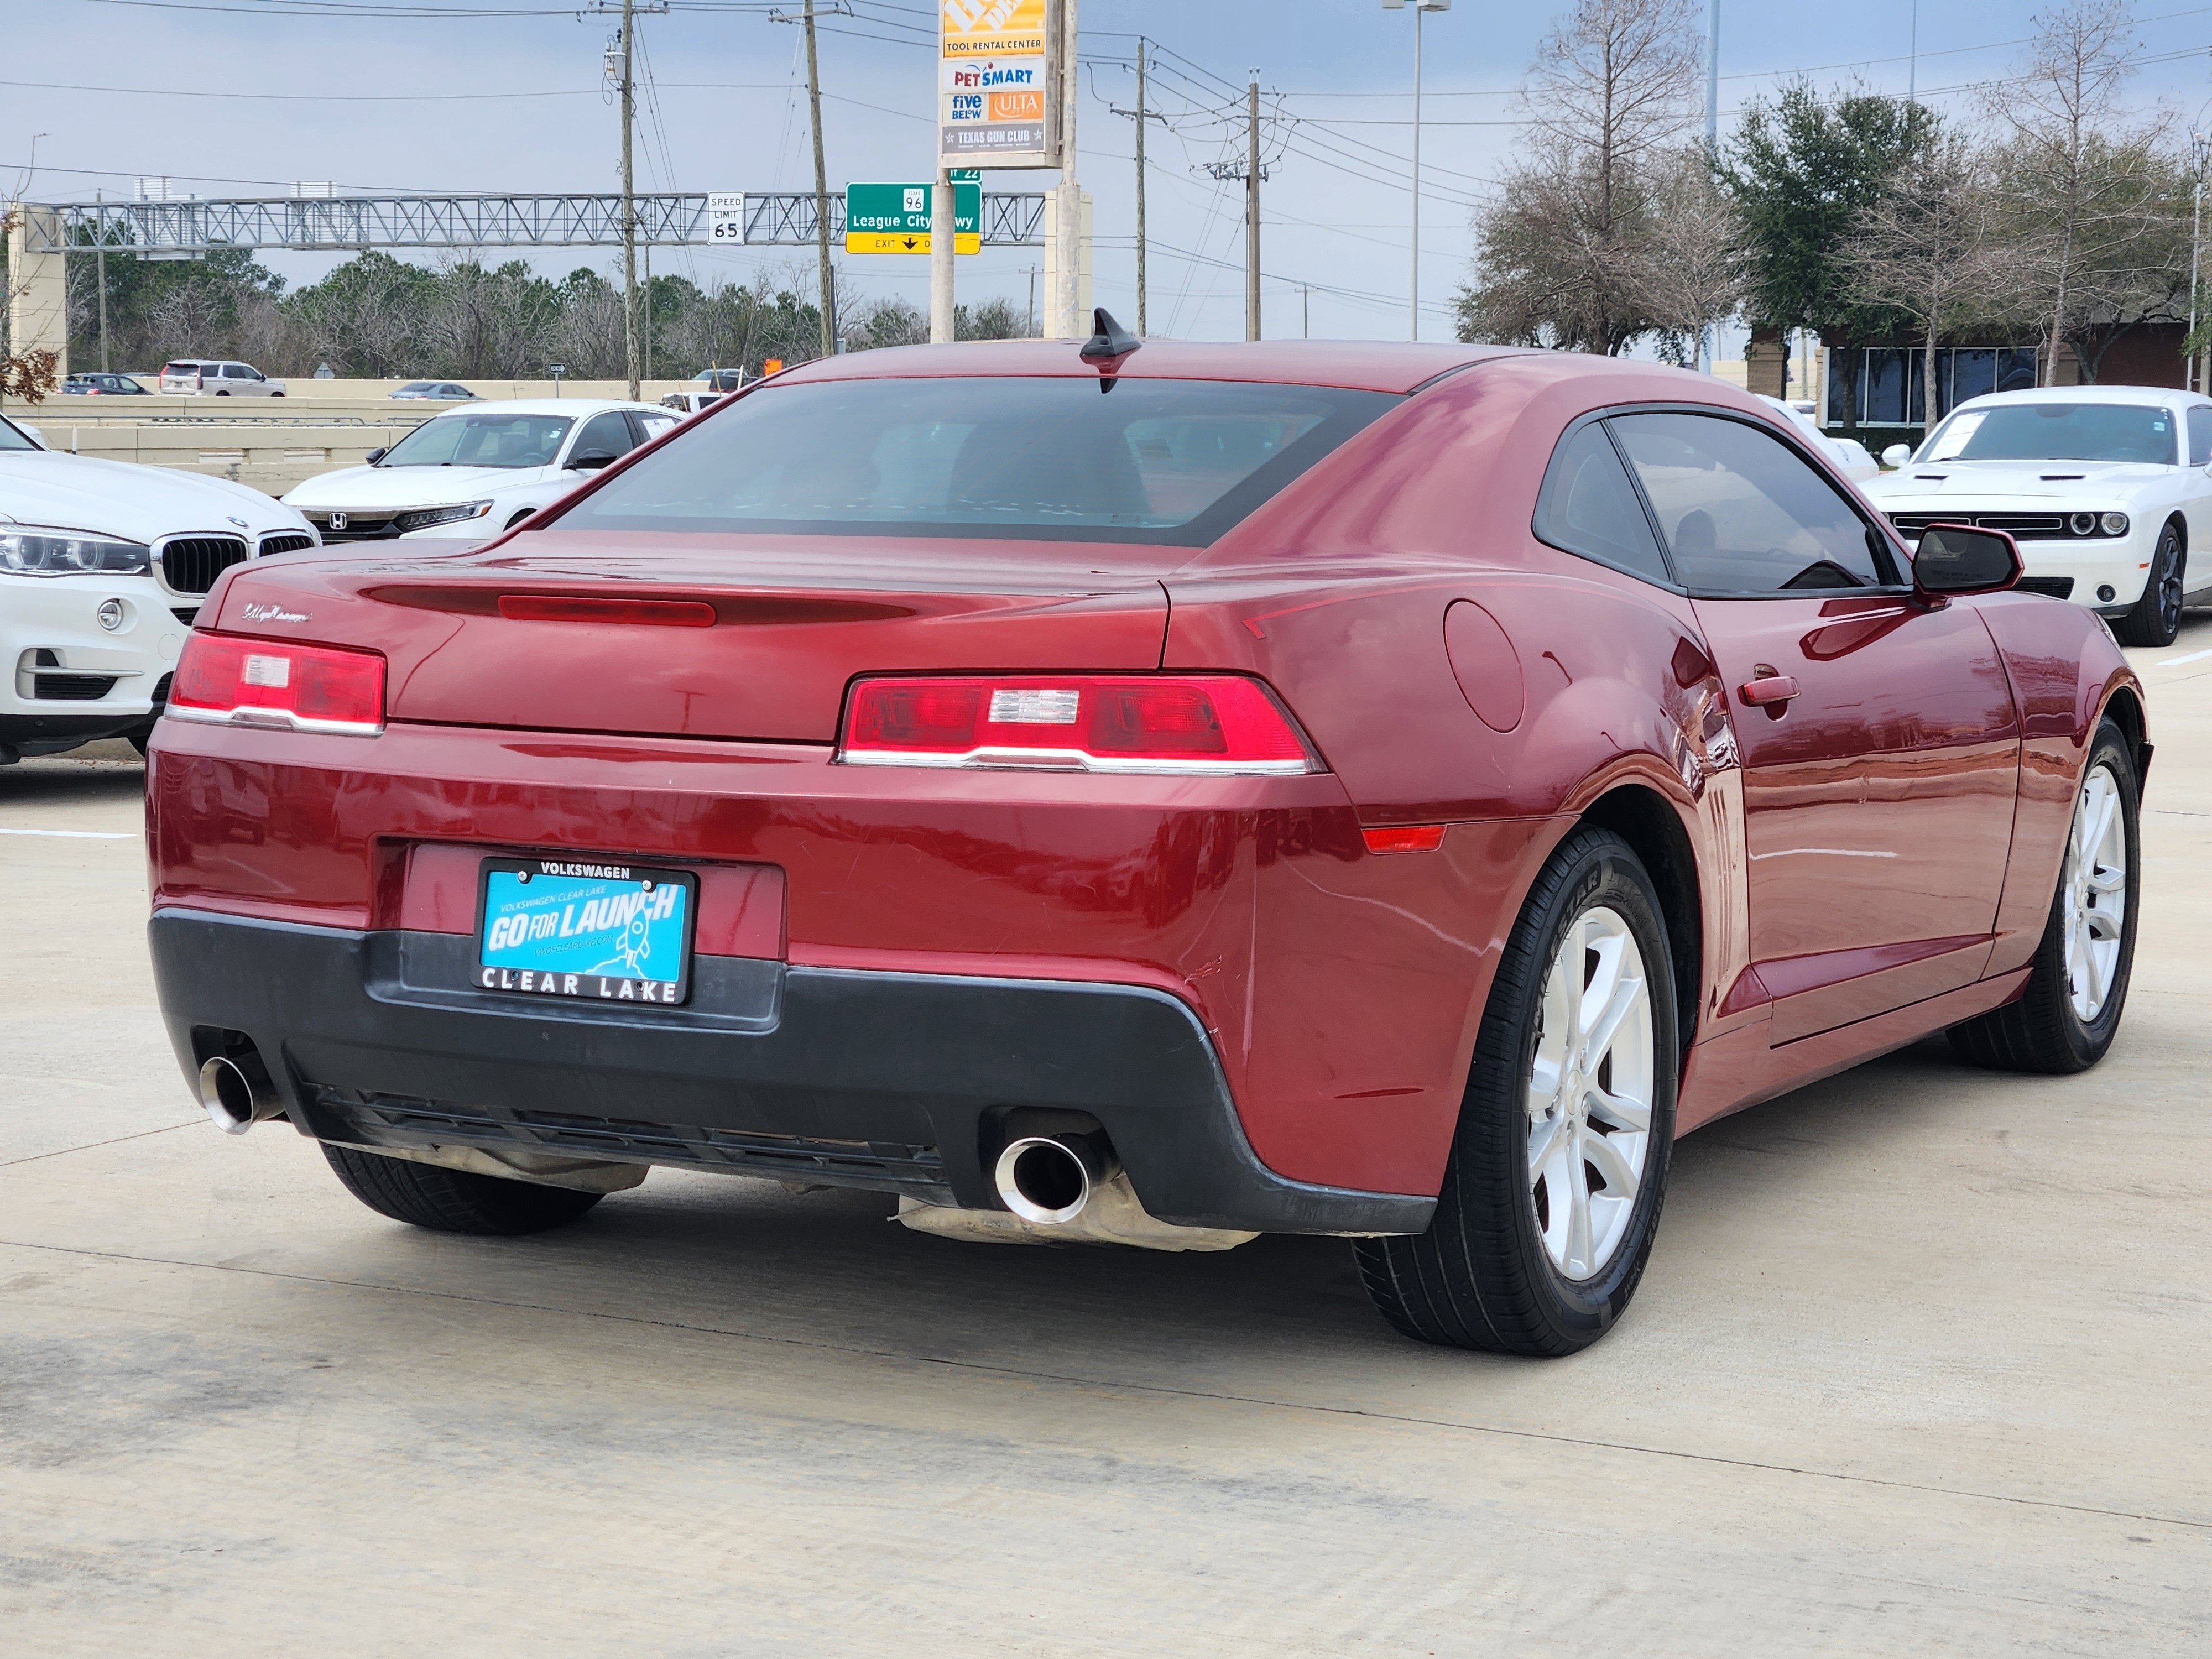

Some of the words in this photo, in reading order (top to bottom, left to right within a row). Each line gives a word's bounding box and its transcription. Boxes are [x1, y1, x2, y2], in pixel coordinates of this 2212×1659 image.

[947, 43, 969, 51] TOOL
[973, 41, 1005, 50] RENTAL
[1008, 40, 1041, 48] CENTER
[954, 69, 1033, 87] PETSMART
[953, 95, 982, 109] five
[1000, 95, 1037, 110] ULTA
[952, 110, 981, 119] BELOW
[958, 131, 985, 144] TEXAS
[987, 131, 1005, 143] GUN
[1007, 129, 1030, 142] CLUB
[906, 197, 921, 208] 96
[853, 215, 900, 229] League
[907, 214, 932, 229] City
[954, 216, 973, 229] wy
[715, 223, 737, 237] 65
[875, 239, 895, 248] EXIT
[540, 862, 630, 879] VOLKSWAGEN
[501, 895, 556, 912] VOLKSWAGEN
[557, 890, 584, 902] CLEAR
[585, 885, 607, 896] LAKE
[488, 912, 529, 951] GO
[527, 912, 559, 941] FOR
[559, 885, 679, 938] LAUNCH
[534, 935, 613, 957] VWOFCLEARLAKE.COM
[482, 967, 578, 995] CLEAR
[599, 977, 676, 1003] LAKE
